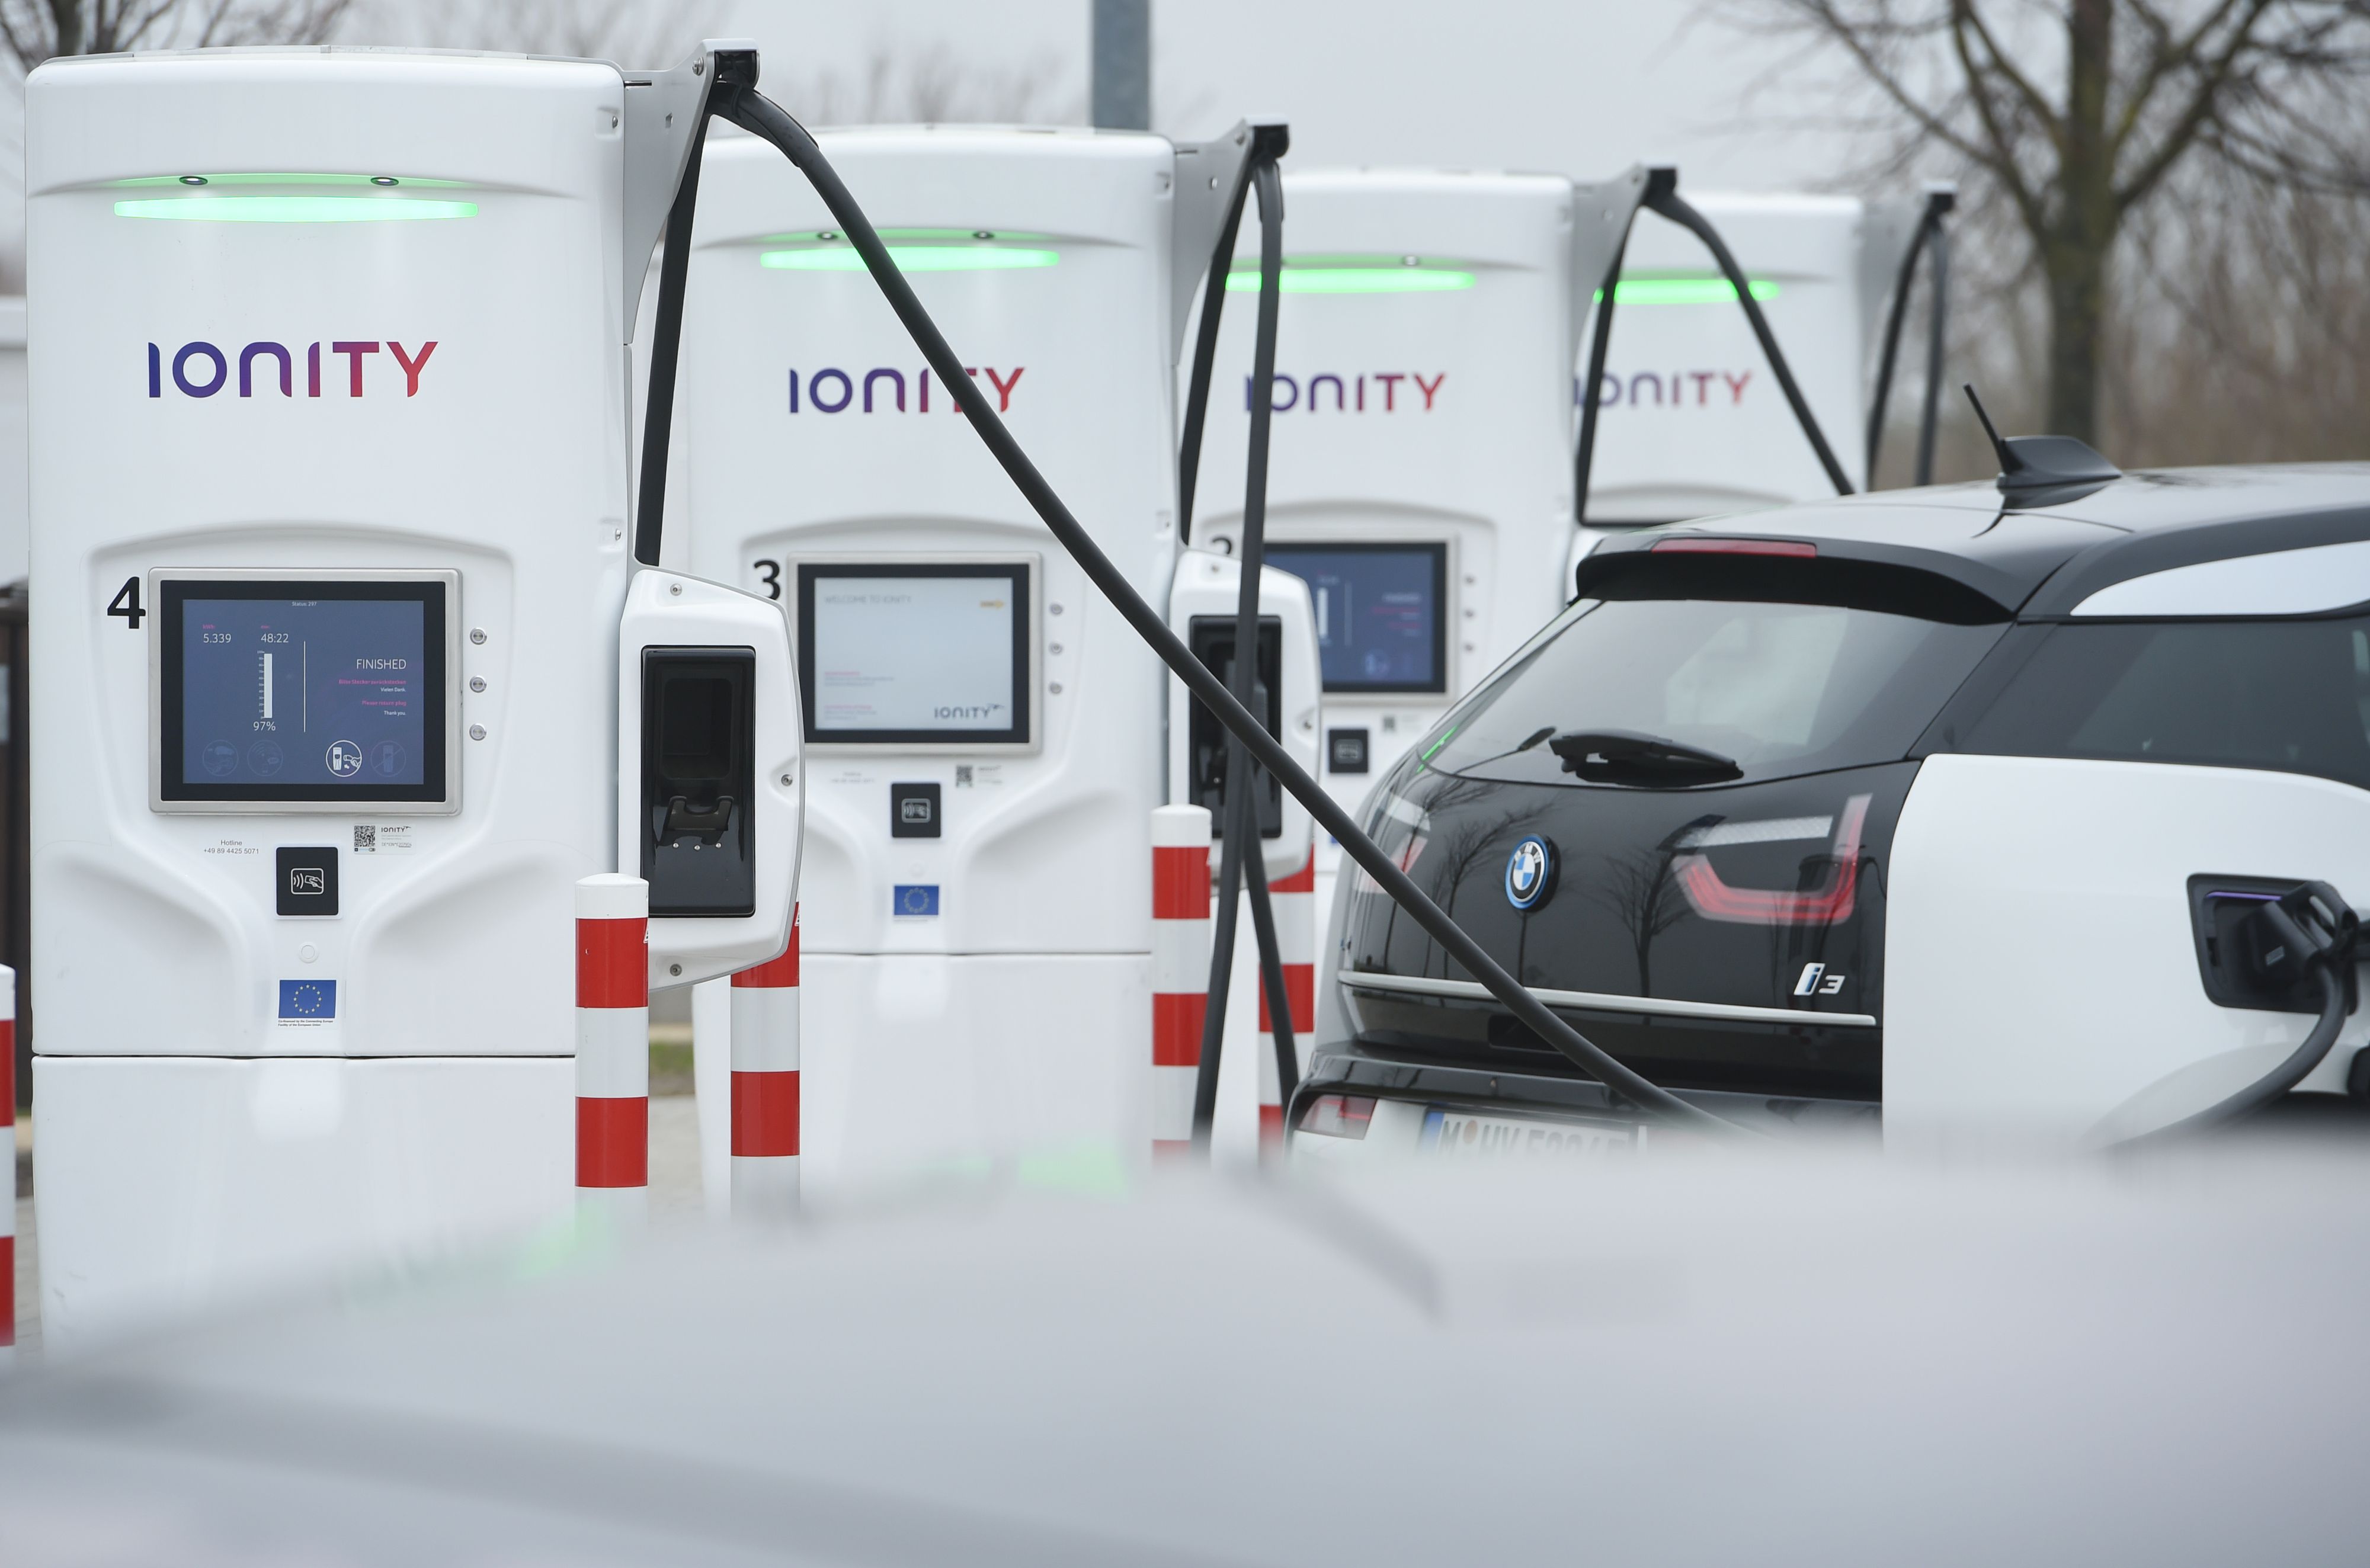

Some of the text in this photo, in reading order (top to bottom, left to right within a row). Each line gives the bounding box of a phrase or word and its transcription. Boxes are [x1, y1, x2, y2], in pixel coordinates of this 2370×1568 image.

[148, 341, 438, 398] IONITY
[754, 559, 780, 601] 3
[107, 576, 146, 629] 4
[203, 633, 289, 643] 5.339 48:22
[356, 659, 406, 670] FINISHED
[934, 706, 991, 719] IONITY
[253, 721, 276, 731] 97%
[1793, 962, 1846, 996] i3
